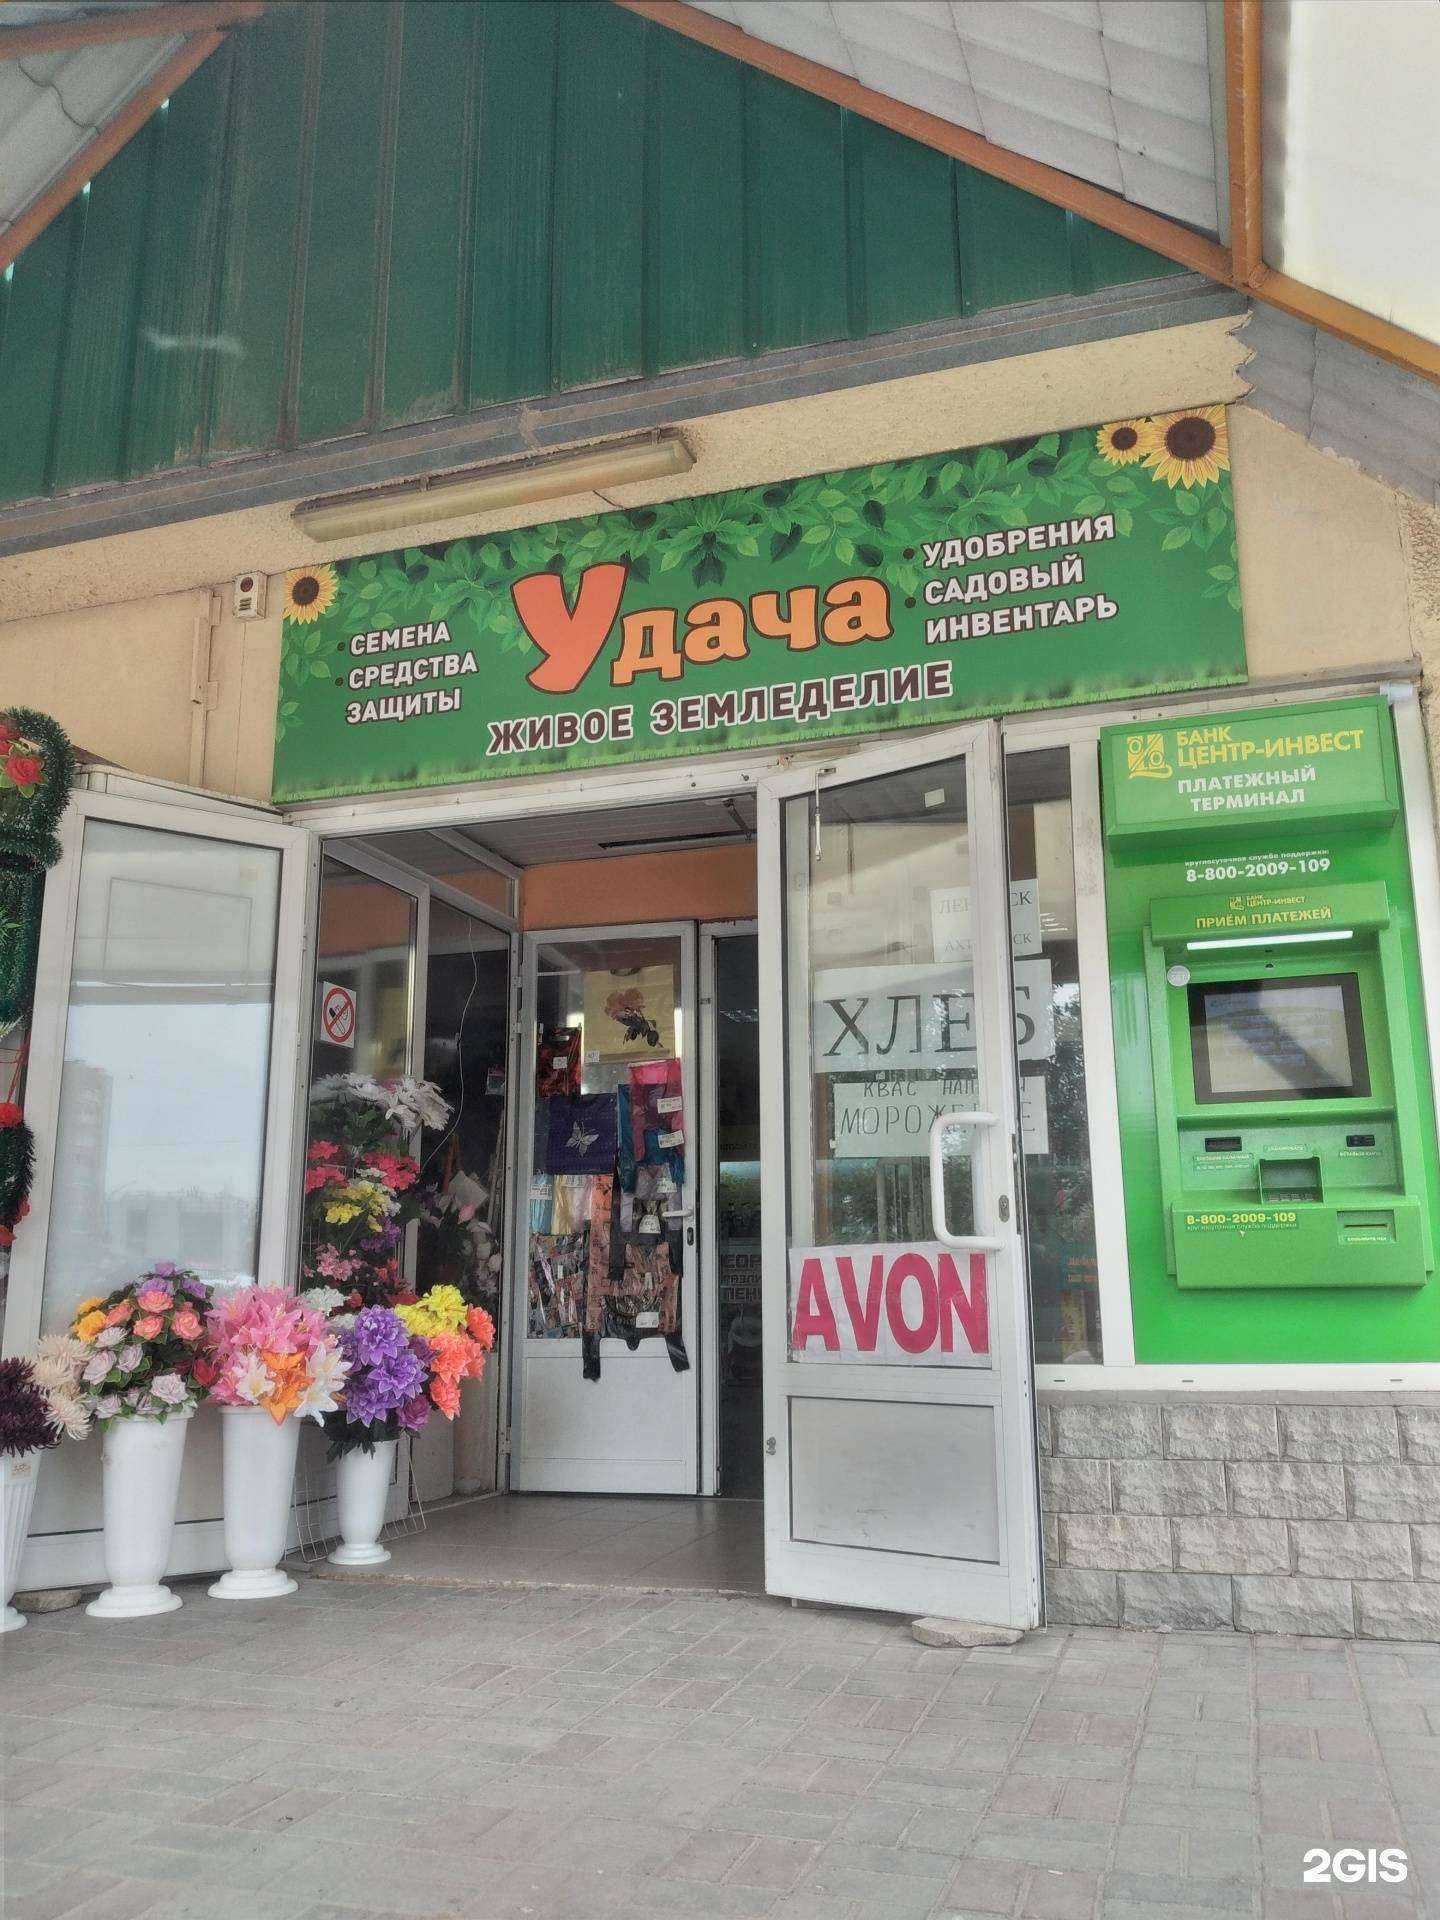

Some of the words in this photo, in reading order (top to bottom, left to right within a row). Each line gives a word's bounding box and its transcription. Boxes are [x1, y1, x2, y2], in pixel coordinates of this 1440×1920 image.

[922, 513, 1115, 568] УДОБРЕНИЯ
[924, 555, 1085, 606] САДОВЫЙ
[510, 562, 894, 694] Удача
[925, 594, 1118, 644] ИНВЕНТАРЬ
[349, 621, 451, 656] СЕМЕНА
[348, 651, 479, 691] СРЕДСТВА
[345, 688, 462, 725] ЗАЩИТЫ
[486, 705, 634, 756] ЖИВОЕ
[650, 660, 953, 735] ЗЕМЛЕДЕЛИЕ
[1176, 726, 1233, 746] БАНК
[1177, 728, 1364, 768] ЦЕНТР-ИНВЕСТ
[1177, 765, 1317, 794] ПЛАТЕЖНЫЙ
[1190, 788, 1305, 812] ТЕРМИНАЛ
[1186, 857, 1331, 882] 8-800-2009-109
[1196, 913, 1247, 929] ПРИЁМ
[1251, 906, 1332, 924] ПЛАТЕЖЕЙ
[863, 1080, 917, 1098] КВАС
[1186, 1212, 1297, 1225] 8-800-2009-109
[791, 1252, 989, 1354] AVON
